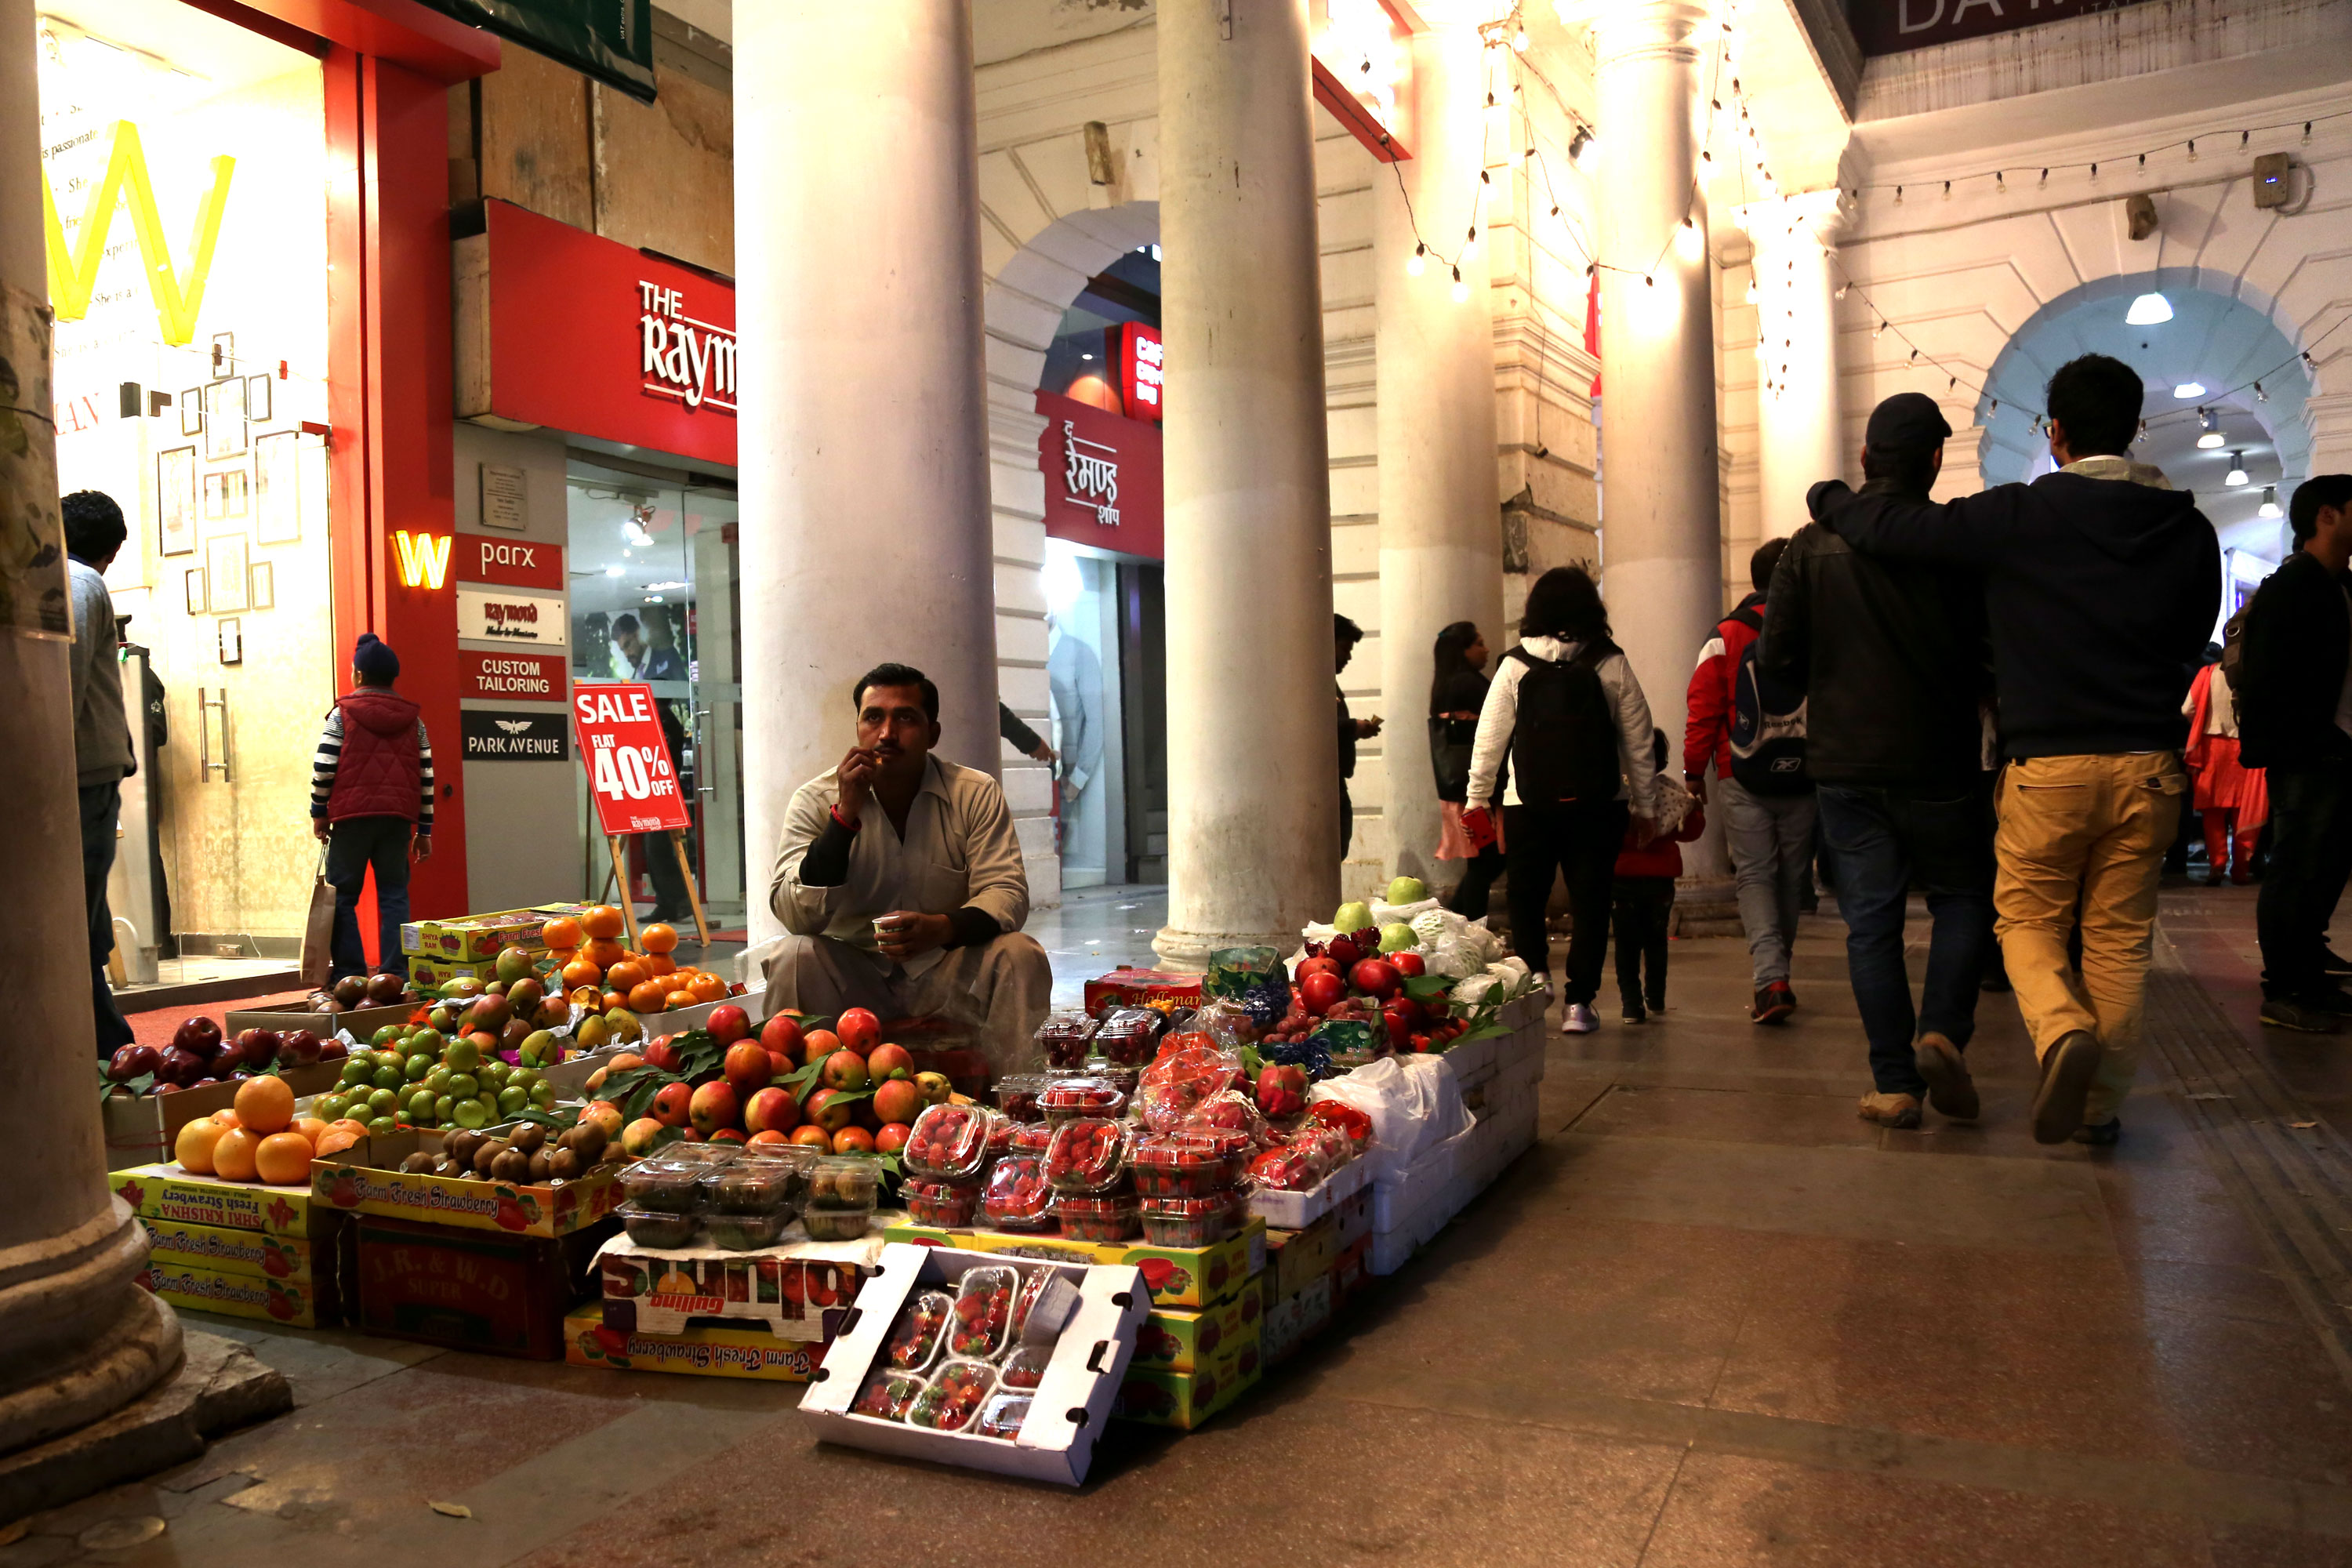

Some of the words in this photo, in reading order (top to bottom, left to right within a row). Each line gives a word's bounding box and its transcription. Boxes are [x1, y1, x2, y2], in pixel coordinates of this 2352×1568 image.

[50, 129, 99, 161] passionate
[639, 280, 683, 320] THE
[641, 314, 738, 407] Raym
[395, 530, 452, 590] W
[481, 542, 536, 576] parx
[481, 659, 540, 677] CUSTOM
[476, 675, 550, 694] TAILORING
[576, 694, 652, 724] SALE
[1762, 717, 1802, 730] Reebok
[468, 736, 506, 753] PARK
[509, 737, 560, 754] AVENUE
[591, 734, 615, 749] FLAT
[594, 745, 670, 801] 40%
[651, 779, 674, 797] OFF
[499, 931, 520, 942] Farm
[1131, 990, 1201, 1006] Hallmar
[227, 1198, 260, 1214] Fresh
[354, 1177, 387, 1201] Farm
[390, 1181, 427, 1207] Fresh
[430, 1185, 499, 1219] Strawberry
[161, 1203, 224, 1223] KRISHNA
[229, 1213, 261, 1228] SHRI
[147, 1226, 174, 1250] Farm
[176, 1231, 207, 1253] Fresh
[209, 1235, 265, 1268] Strawberry
[151, 1268, 179, 1291] Farm
[182, 1273, 211, 1297] Fresh
[214, 1277, 270, 1308] Strawberry
[407, 1277, 463, 1300] SUPER
[626, 1338, 710, 1368] Strawberry
[713, 1346, 762, 1371] Fresh
[764, 1350, 810, 1374] Farm
